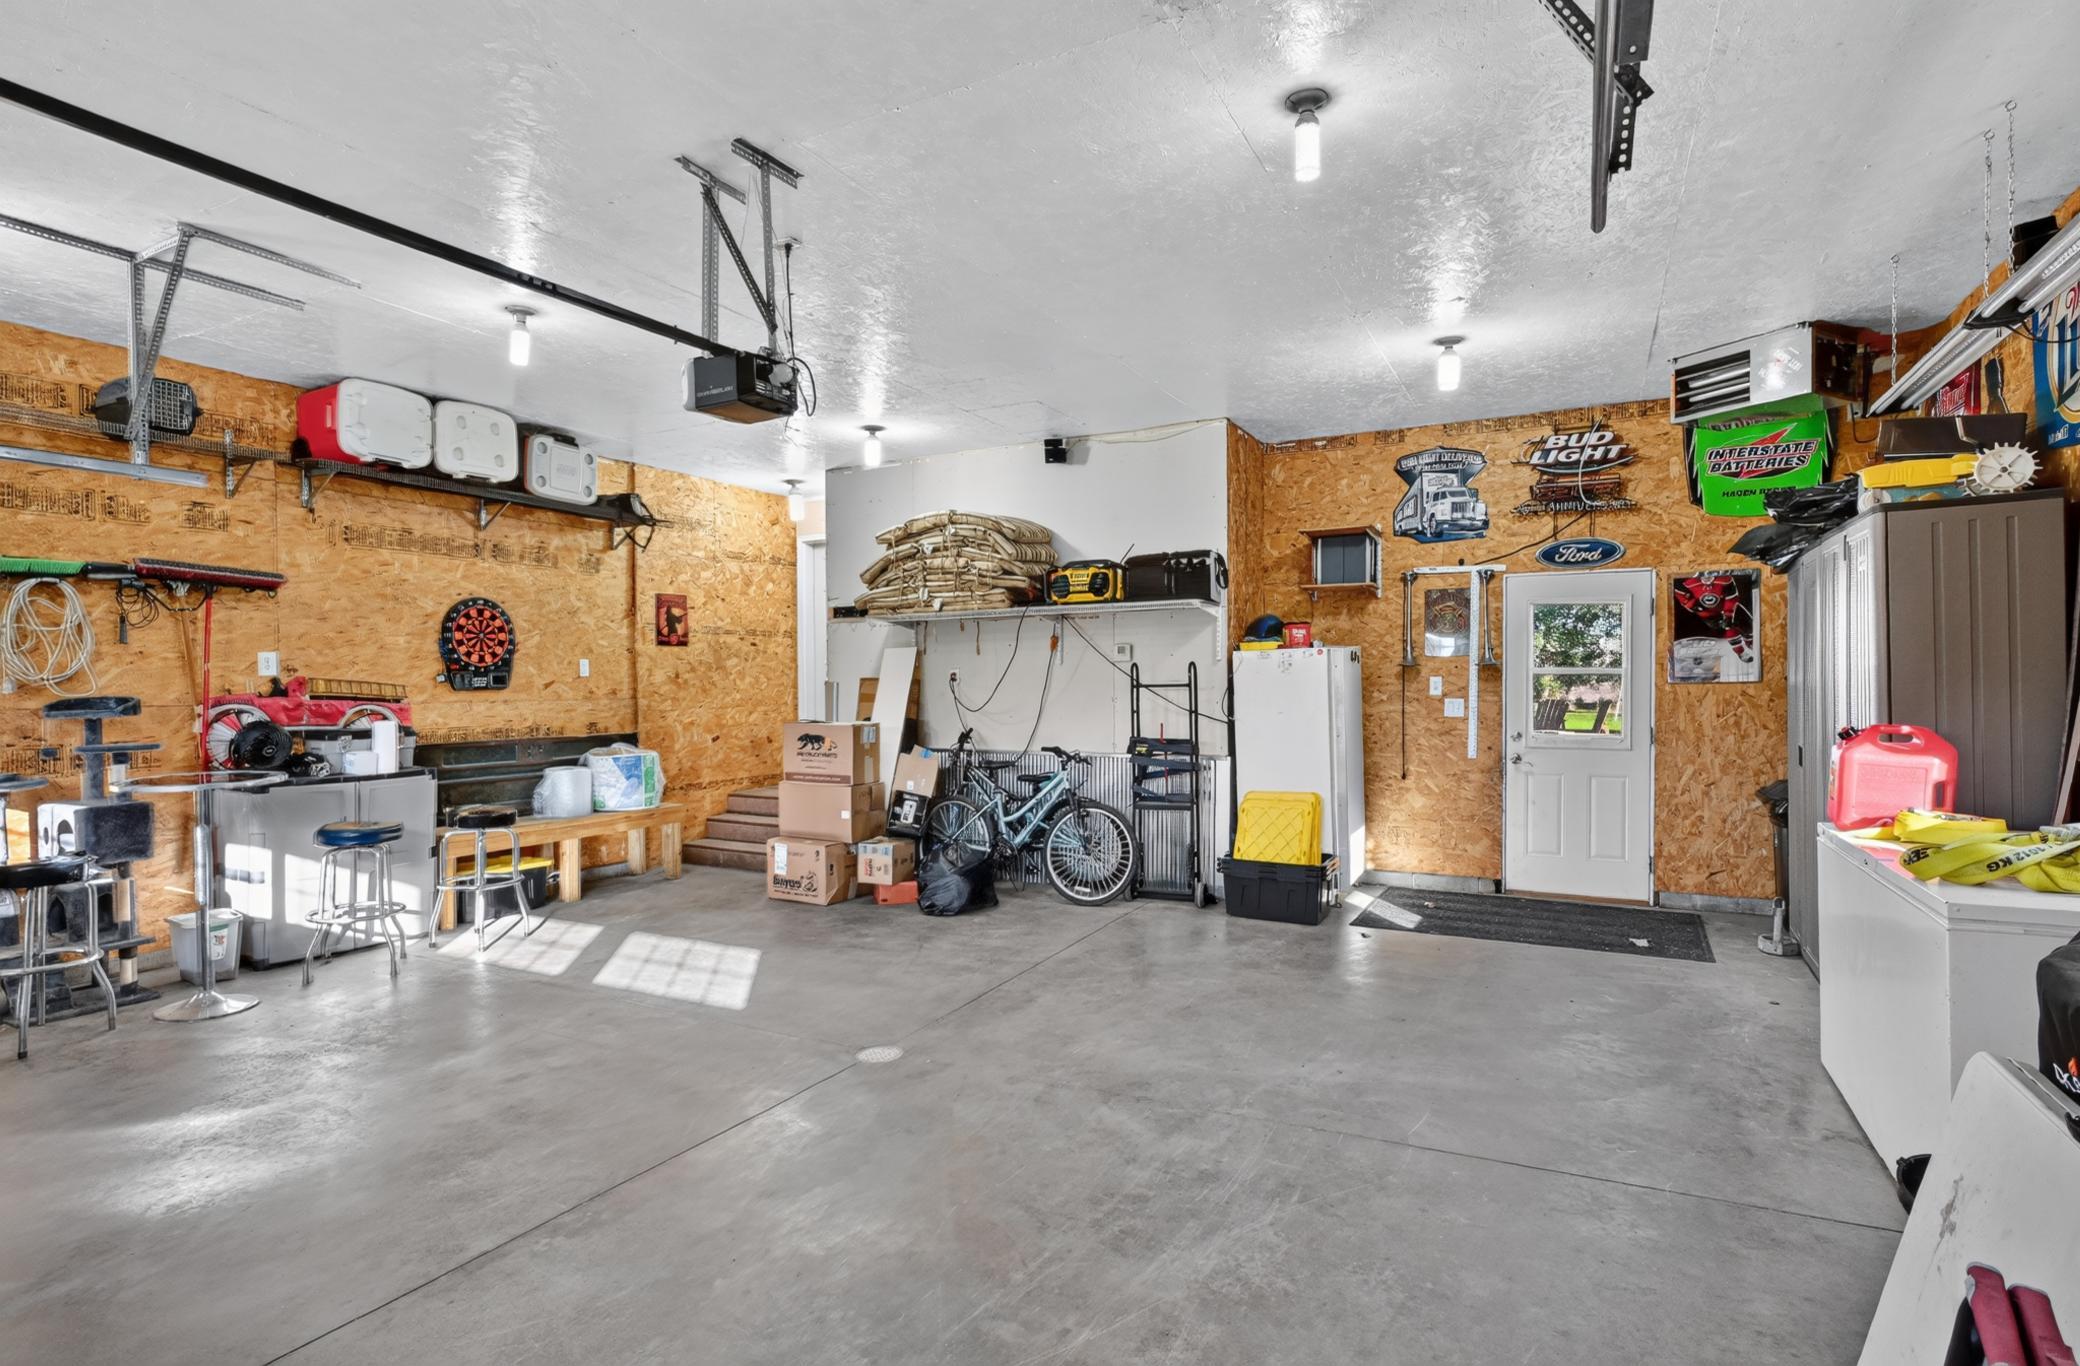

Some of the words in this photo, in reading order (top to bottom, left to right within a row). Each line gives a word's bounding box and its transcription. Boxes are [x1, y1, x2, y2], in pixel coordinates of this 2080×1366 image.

[1545, 431, 1614, 449] BUD
[1529, 444, 1628, 465] LIGHT
[1708, 440, 1817, 461] INTERSTATE
[1709, 455, 1810, 473] BATTERIES
[1555, 543, 1603, 562] Ford
[1986, 857, 2013, 873] KG
